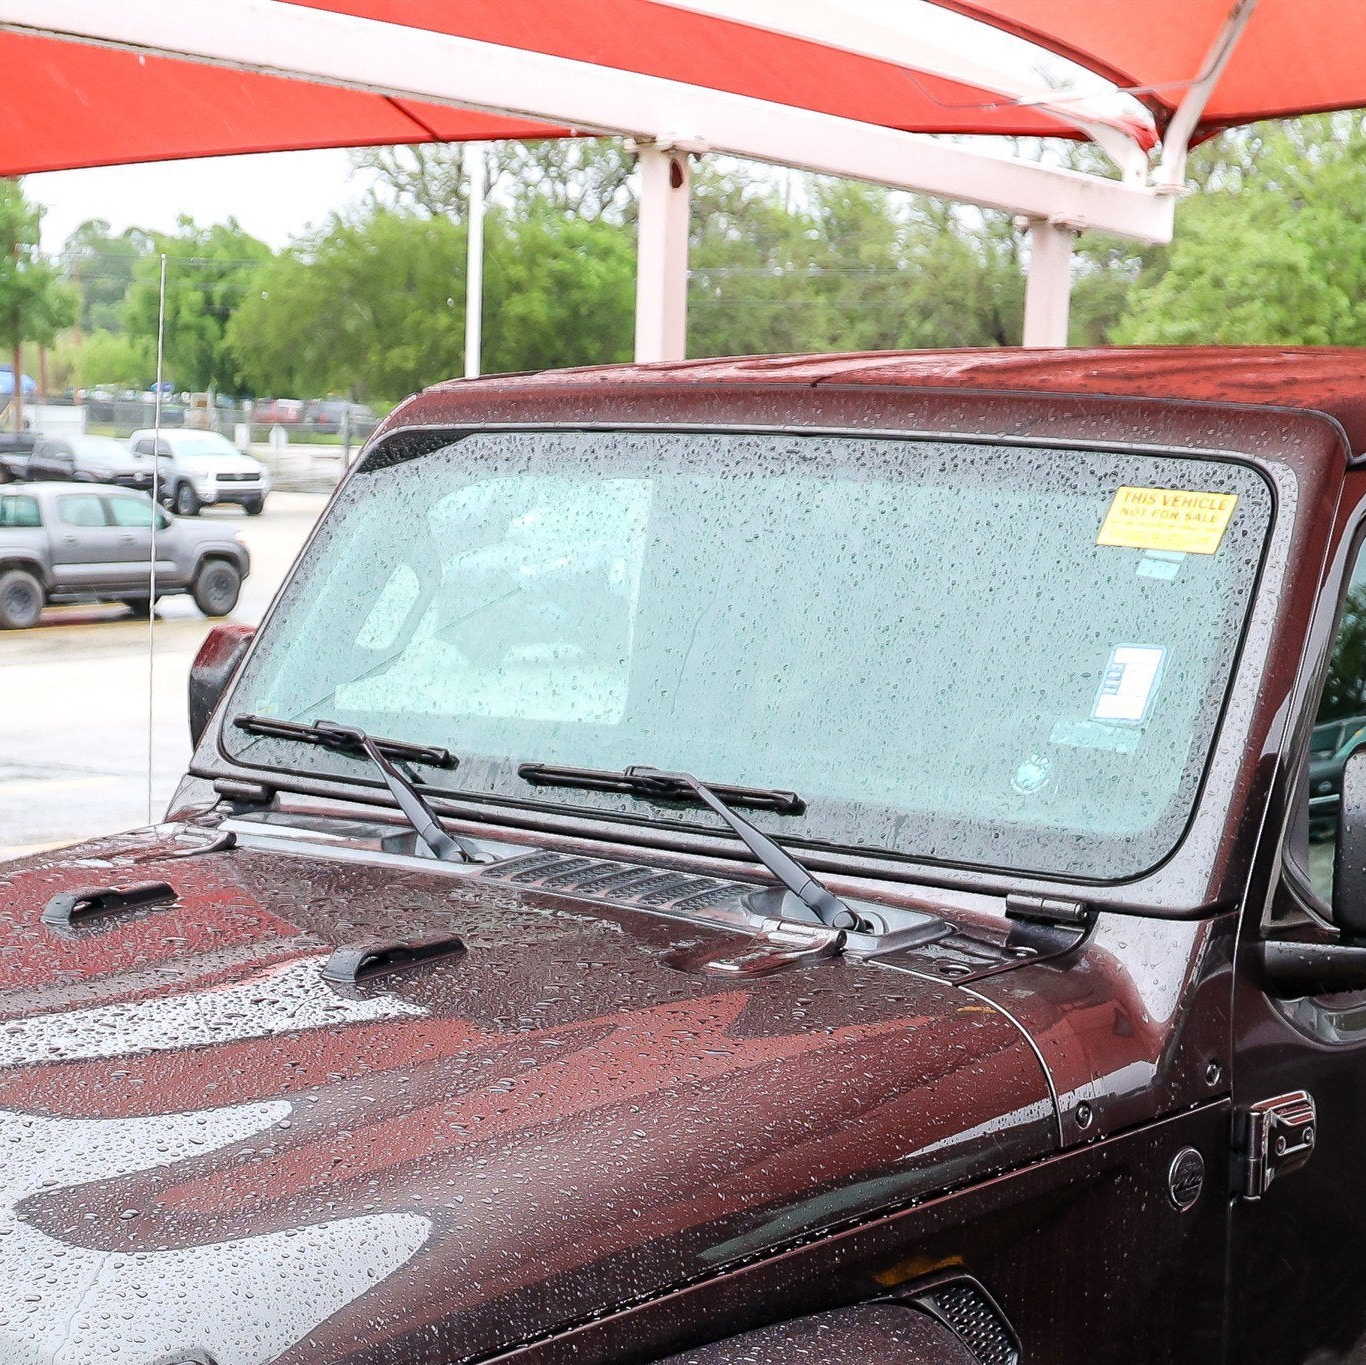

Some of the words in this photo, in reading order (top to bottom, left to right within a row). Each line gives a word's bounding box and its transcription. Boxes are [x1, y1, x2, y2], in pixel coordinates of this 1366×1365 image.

[1124, 491, 1156, 506] THIS
[1162, 494, 1231, 511] VEHICLE
[1120, 507, 1147, 517] NOT
[1151, 509, 1179, 520] FOR
[1185, 513, 1220, 523] SALE
